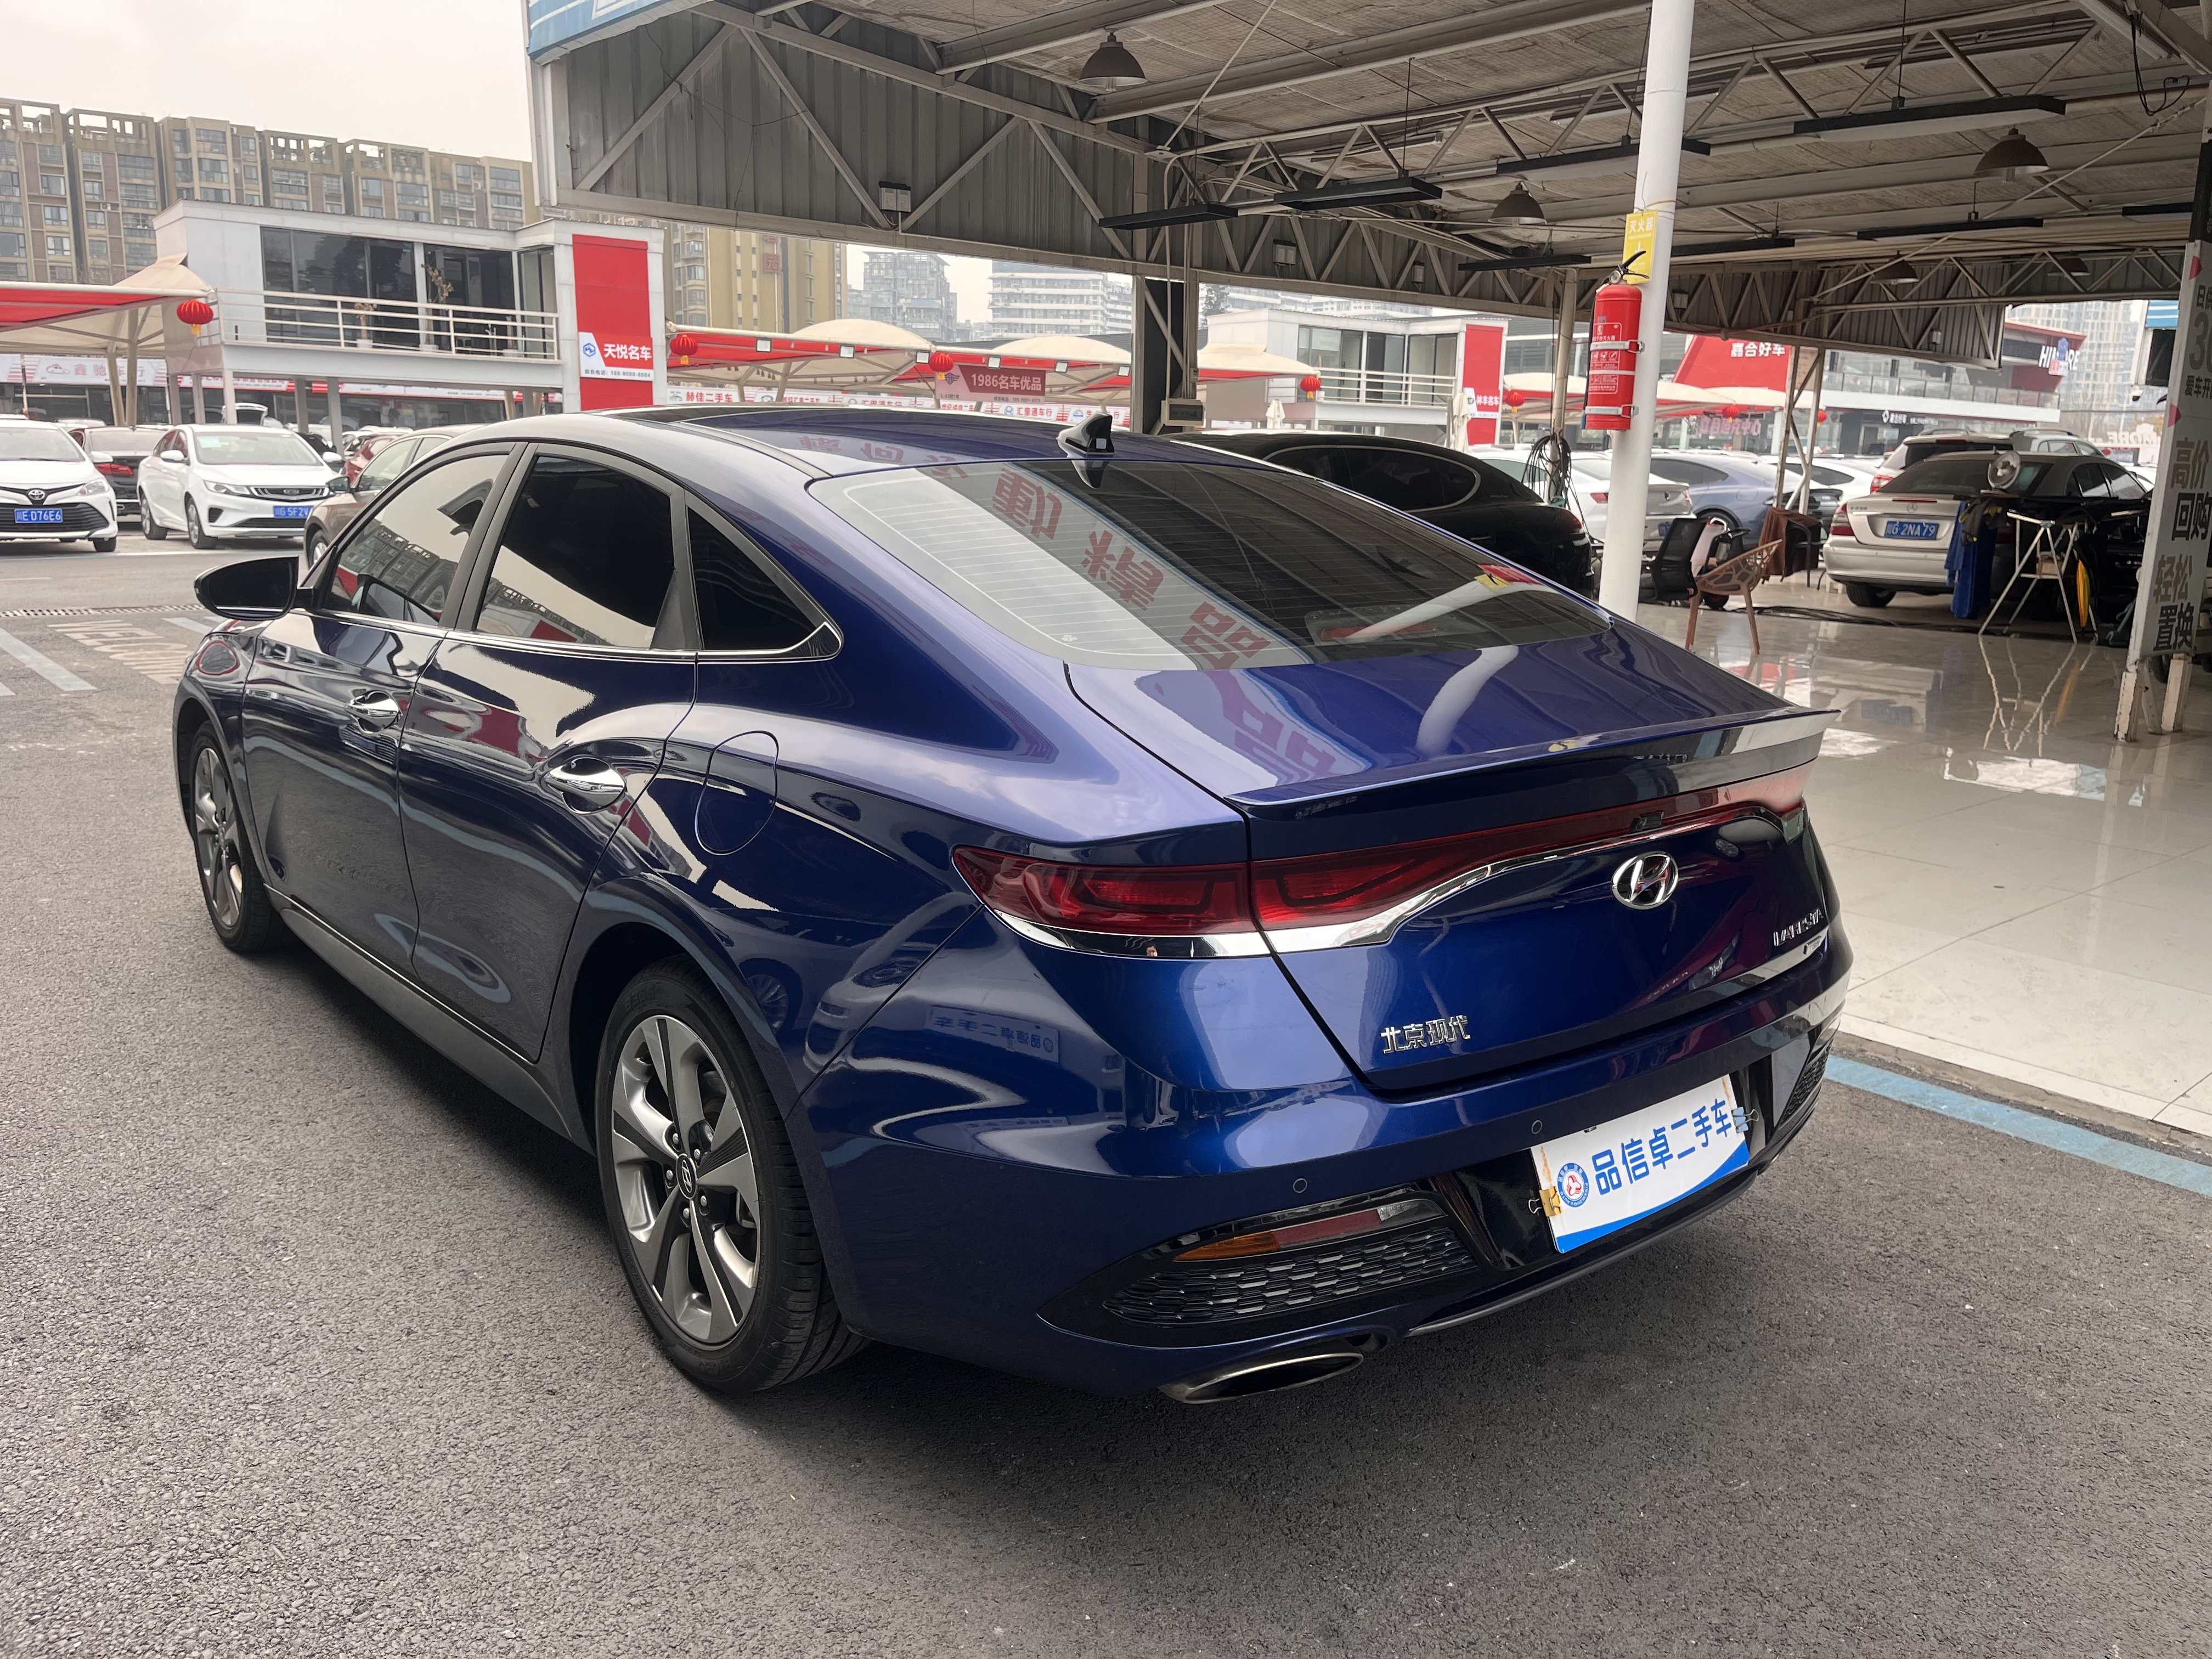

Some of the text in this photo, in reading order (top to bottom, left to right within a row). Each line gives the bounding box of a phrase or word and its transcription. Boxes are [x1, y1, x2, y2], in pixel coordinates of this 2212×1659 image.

[1629, 217, 1654, 234] 灭火器
[603, 343, 652, 361] 天悦名车
[2038, 345, 2080, 371] HIRE
[686, 392, 733, 403] 赫佳二手车
[971, 374, 1042, 391] 1986名车优品
[2170, 437, 2209, 489] 高价
[2171, 492, 2212, 541] 回购
[2153, 554, 2193, 603] 轻松
[2153, 602, 2194, 652] 置换
[1380, 1014, 1471, 1054] 北京现代
[1592, 1098, 1732, 1196] 品信卓二手车
